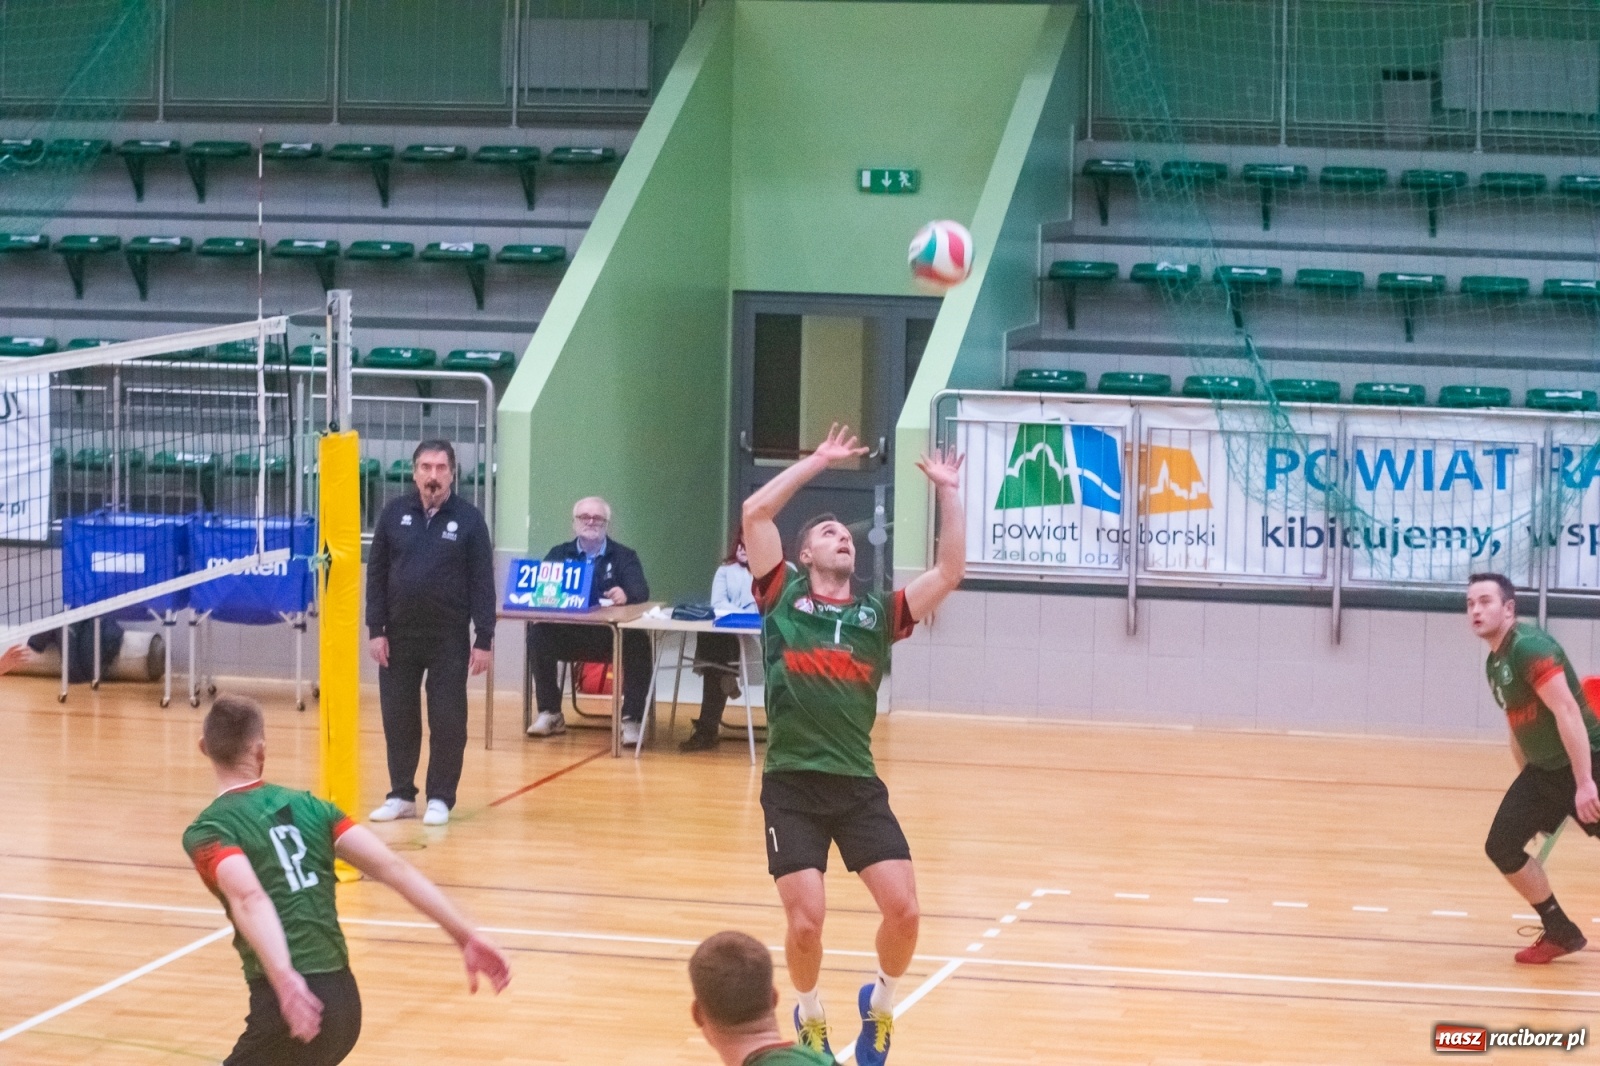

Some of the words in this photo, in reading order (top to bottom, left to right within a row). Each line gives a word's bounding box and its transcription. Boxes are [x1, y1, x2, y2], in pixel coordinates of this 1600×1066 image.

[1266, 448, 1519, 491] POWIAT
[992, 518, 1079, 545] powiat
[1096, 523, 1216, 546] racborski
[1262, 515, 1502, 557] kibicujemy,
[517, 564, 538, 588] 21
[565, 566, 582, 590] 11
[269, 824, 319, 892] 12
